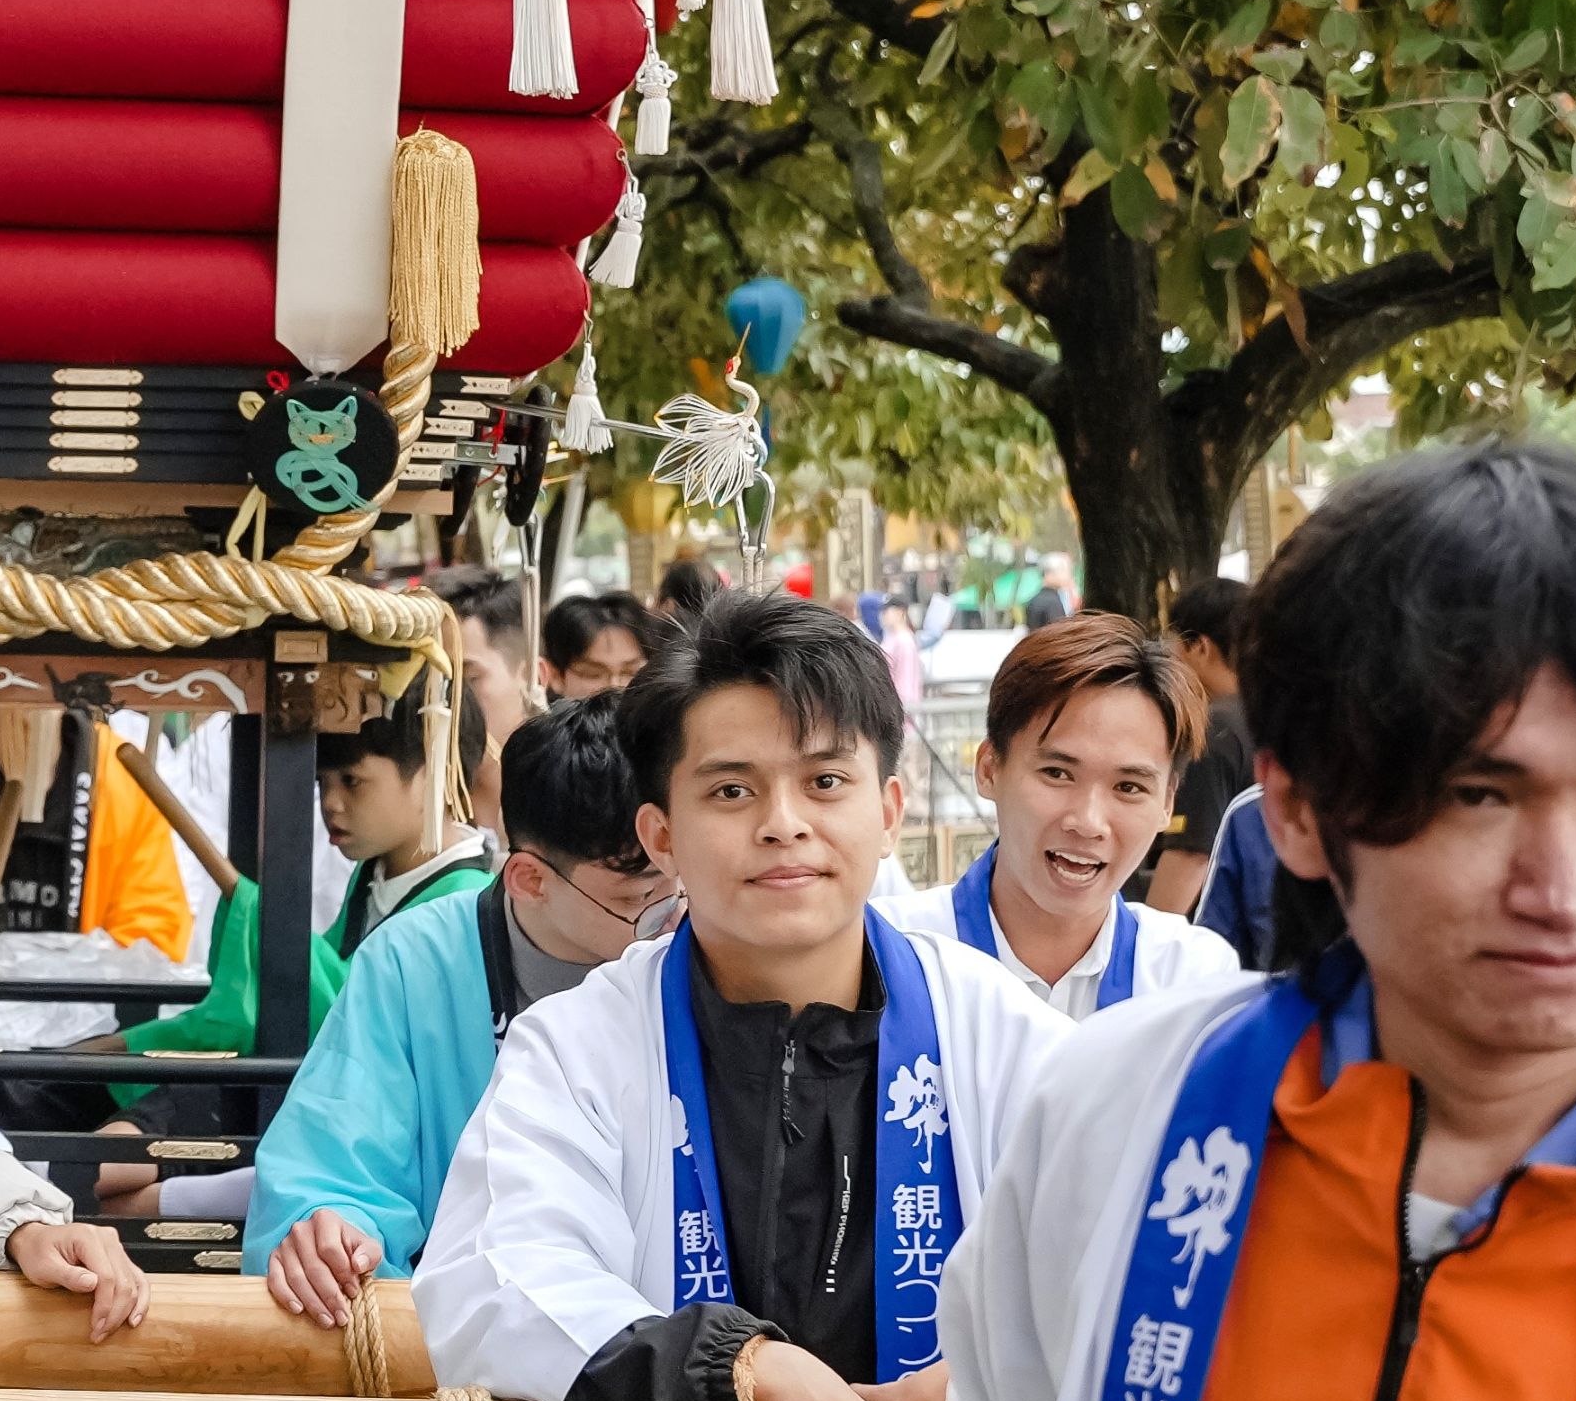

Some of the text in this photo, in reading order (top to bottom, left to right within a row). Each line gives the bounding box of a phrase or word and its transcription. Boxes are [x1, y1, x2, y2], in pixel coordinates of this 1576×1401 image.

[884, 1053, 950, 1381] 堺観光コン
